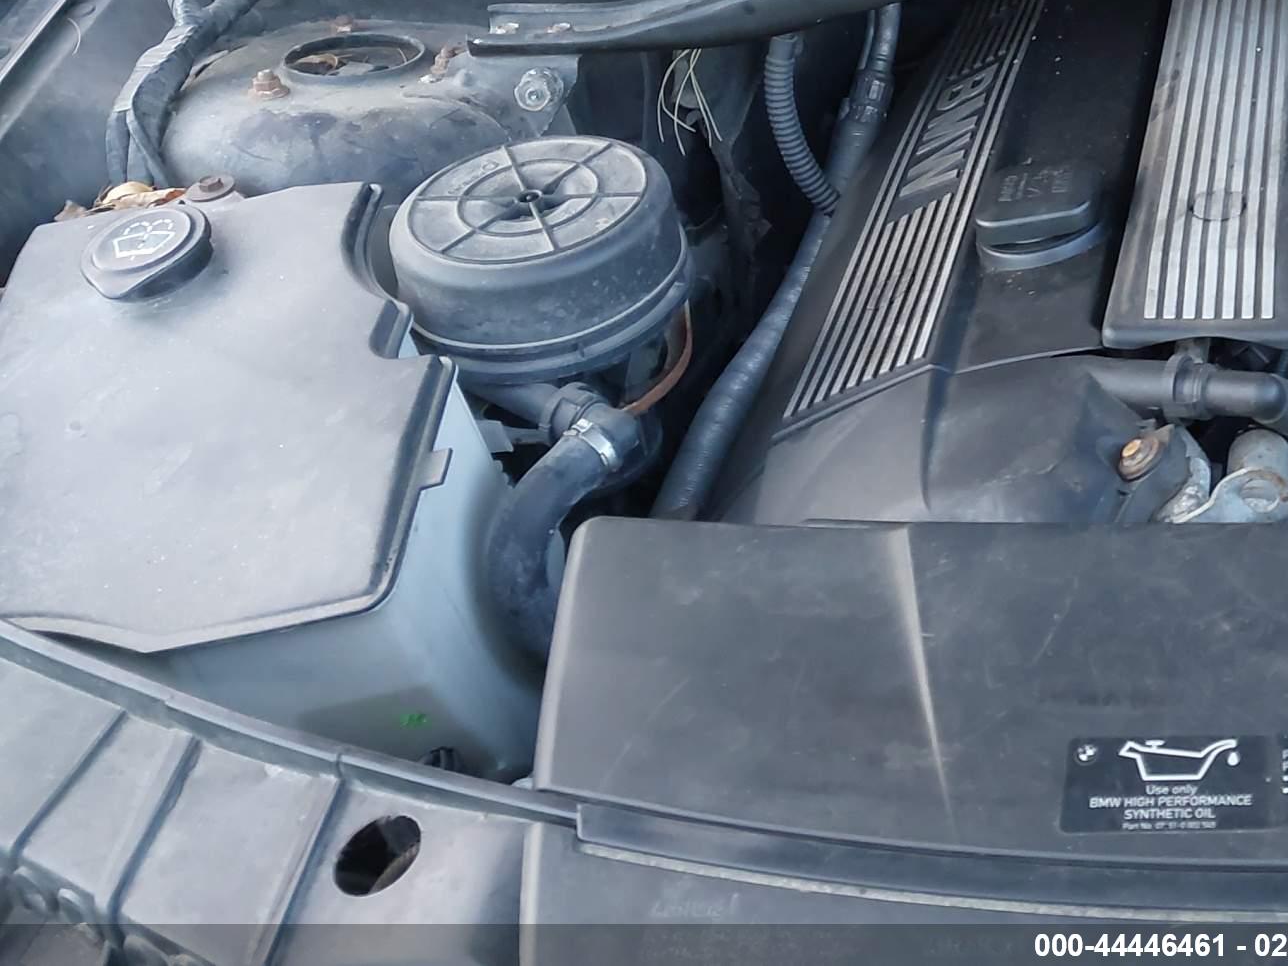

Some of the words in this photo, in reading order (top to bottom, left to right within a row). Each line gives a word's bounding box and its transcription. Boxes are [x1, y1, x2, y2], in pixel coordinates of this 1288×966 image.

[899, 61, 1000, 199] BMW
[1145, 784, 1170, 795] Use
[1172, 783, 1198, 796] only
[1089, 796, 1122, 808] BMW
[1124, 795, 1155, 807] HIGH
[1157, 794, 1253, 807] PERFORMANCE
[1124, 808, 1193, 820] SYNTHETIC
[1194, 807, 1218, 819] OIL
